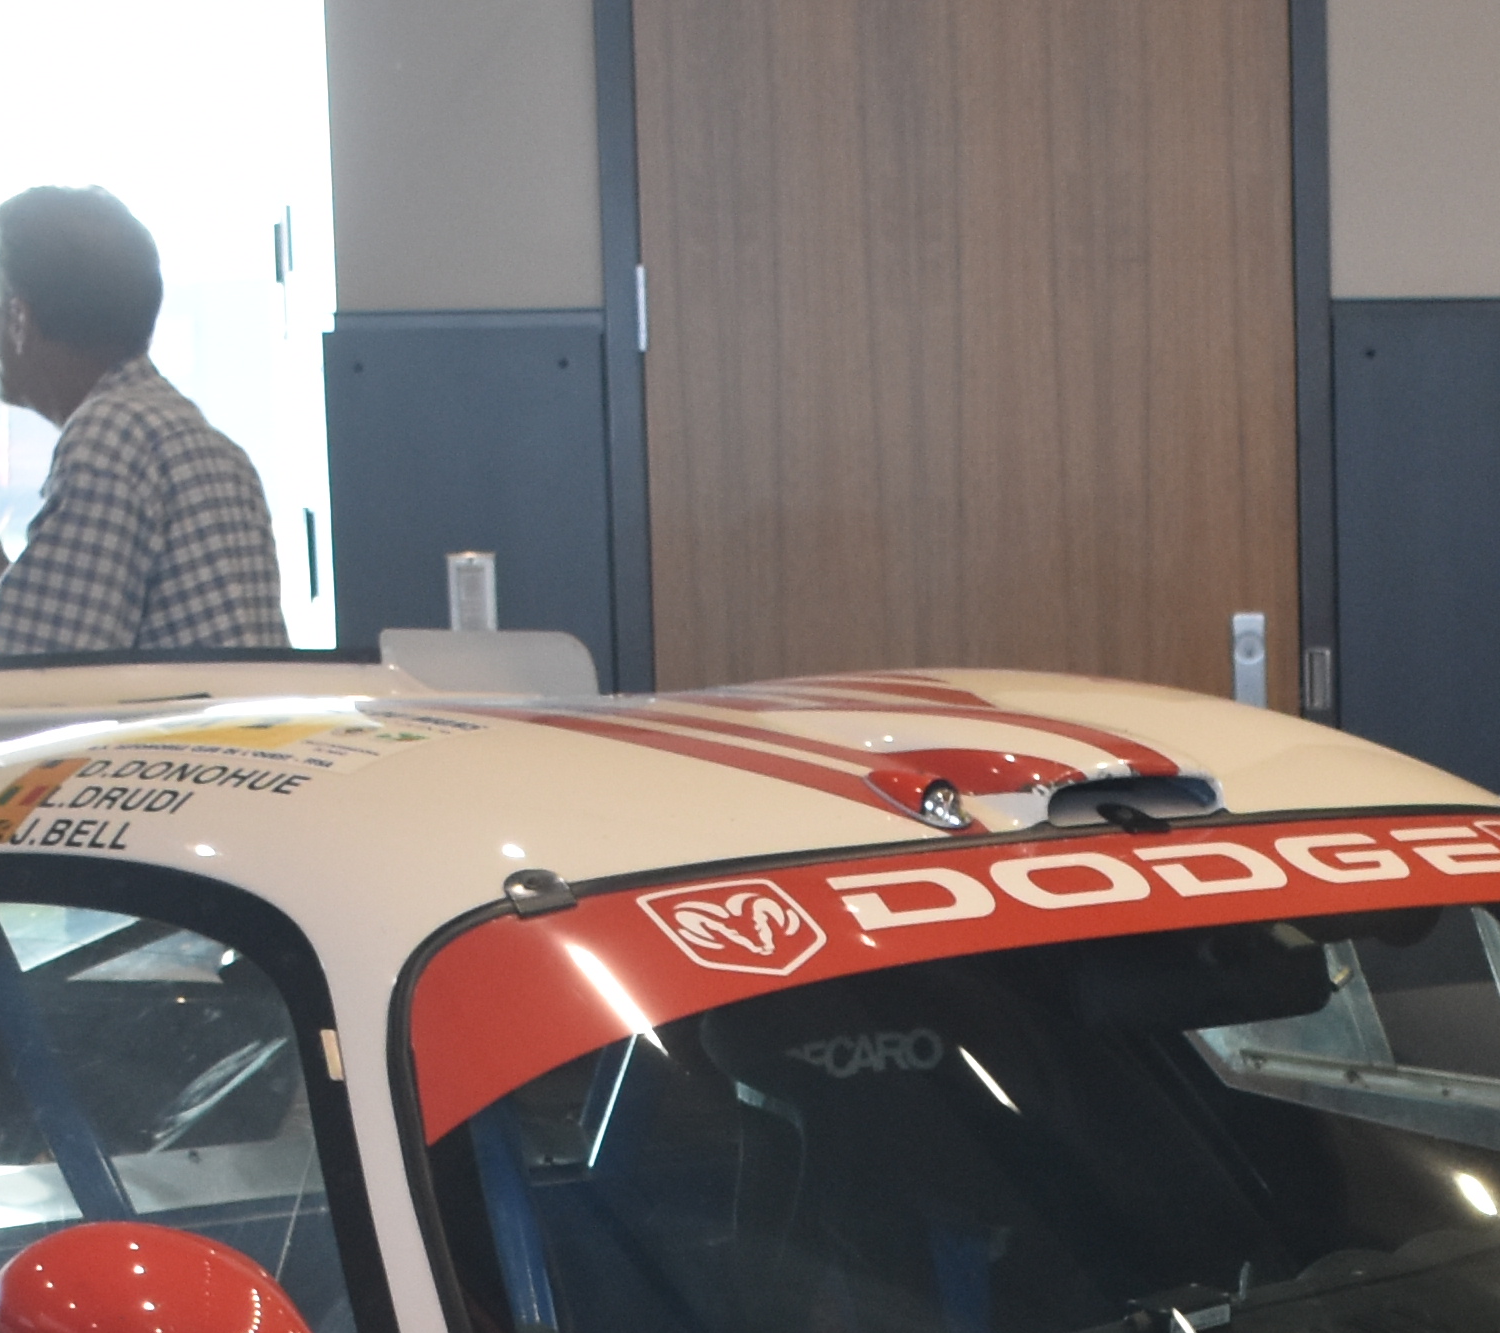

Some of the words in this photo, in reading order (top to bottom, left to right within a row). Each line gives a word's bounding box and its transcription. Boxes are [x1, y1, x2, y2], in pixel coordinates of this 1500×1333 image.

[77, 759, 311, 795] D.DONOHUE
[40, 785, 194, 815] L.DRUDI
[10, 817, 132, 850] J.BELL
